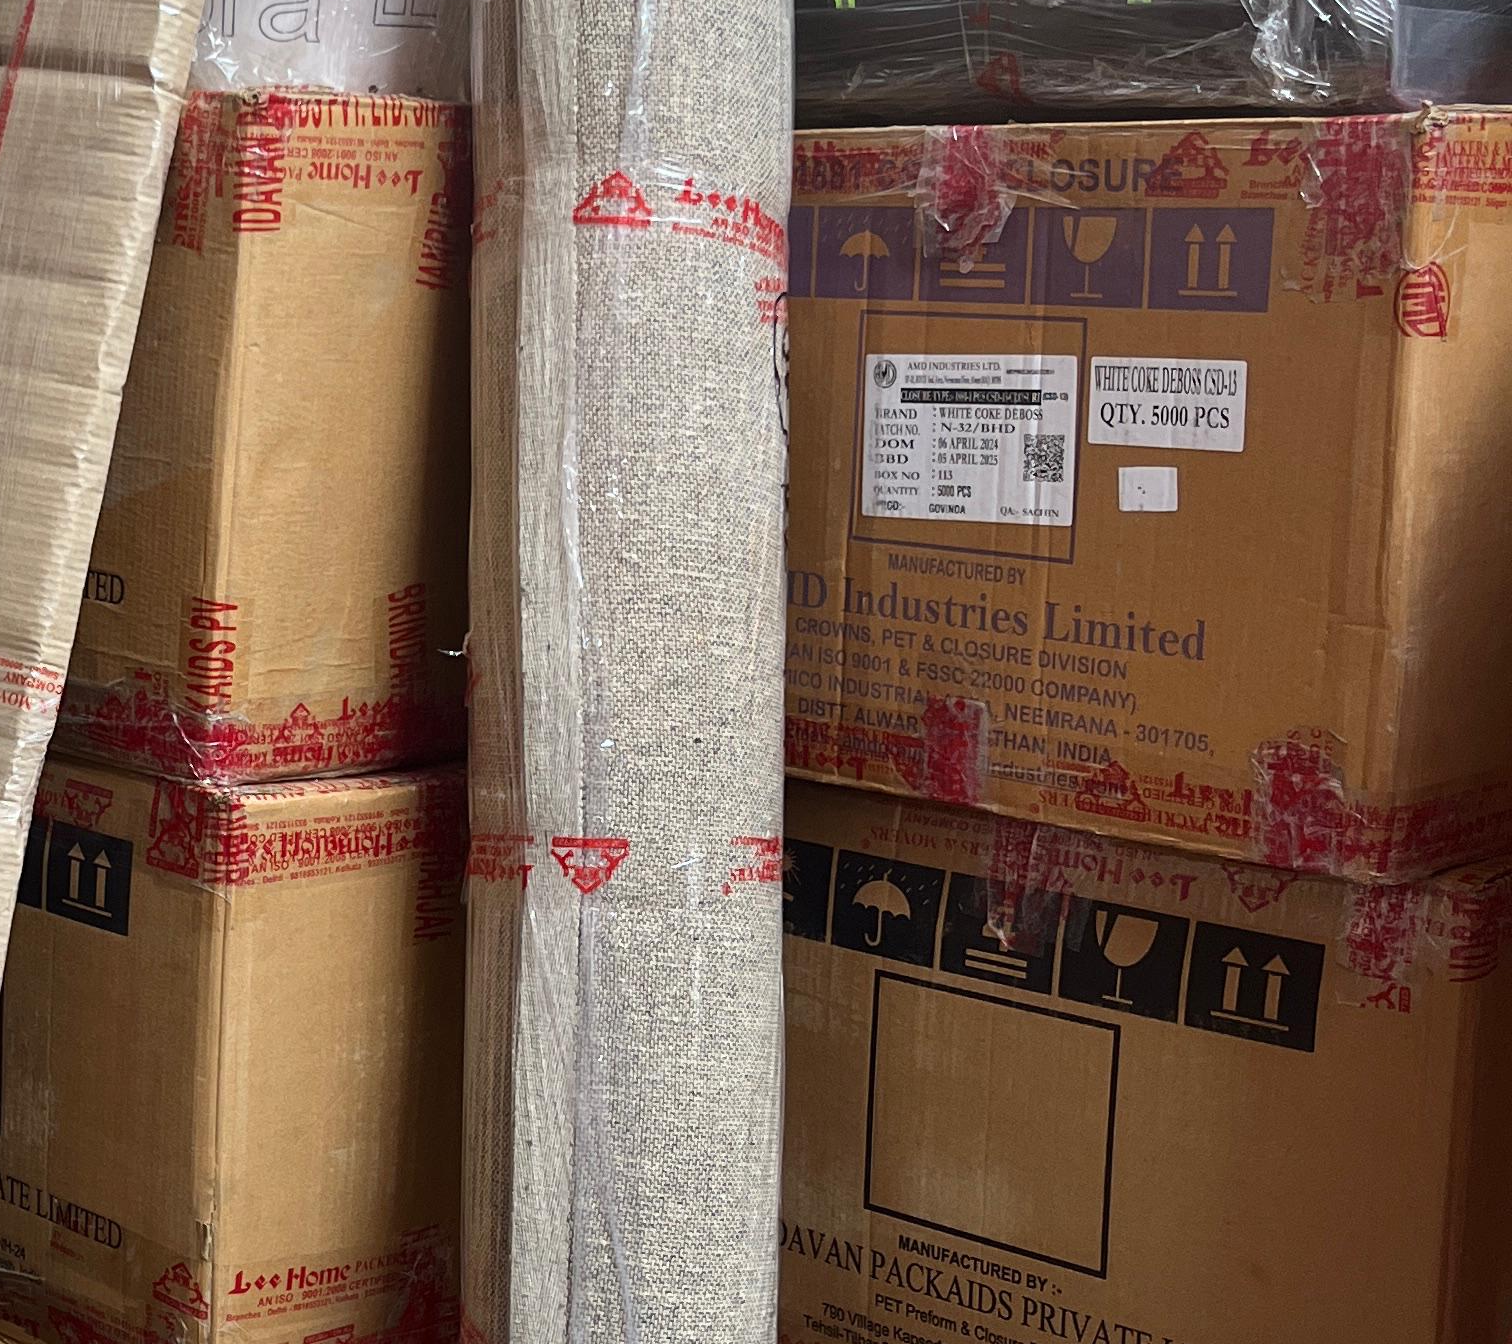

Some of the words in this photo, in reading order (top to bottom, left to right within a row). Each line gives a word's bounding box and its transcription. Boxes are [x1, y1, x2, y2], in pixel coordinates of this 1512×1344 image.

[307, 162, 372, 189] Home
[1095, 365, 1129, 392] WHITE
[1131, 366, 1159, 392] COKE
[1162, 367, 1201, 395] DEBOSS
[939, 409, 972, 420] WHITE
[975, 409, 1001, 420] COKE
[1004, 409, 1043, 420] DEBOSS
[1100, 402, 1146, 428] QTY.
[1151, 406, 1188, 426] 5000
[1194, 407, 1229, 428] PCS
[949, 439, 978, 450] APRIL
[949, 454, 978, 465] APRIL
[889, 553, 1003, 582] MANUFACTURED
[1007, 567, 1026, 586] BY
[843, 576, 1028, 636] Industries
[1044, 600, 1205, 660] Limited
[818, 647, 846, 666] ISO
[851, 653, 890, 672] 9001
[898, 659, 910, 676] &
[916, 662, 965, 684] FSSC
[882, 629, 916, 649] PET
[923, 635, 934, 651] &
[940, 637, 1032, 666] CLOSURE
[1039, 649, 1127, 679] DIVISION
[35, 1188, 122, 1249] LIMITED
[228, 1270, 281, 1295] Lee
[286, 1264, 352, 1291] Home
[898, 1235, 1022, 1285] MANUFACTURED
[1026, 1273, 1048, 1292] BY
[869, 1248, 1013, 1322] PACKAIDS
[848, 1311, 890, 1338] Village
[874, 1293, 903, 1314] PET
[906, 1303, 957, 1333] Preform
[961, 1321, 970, 1337] &
